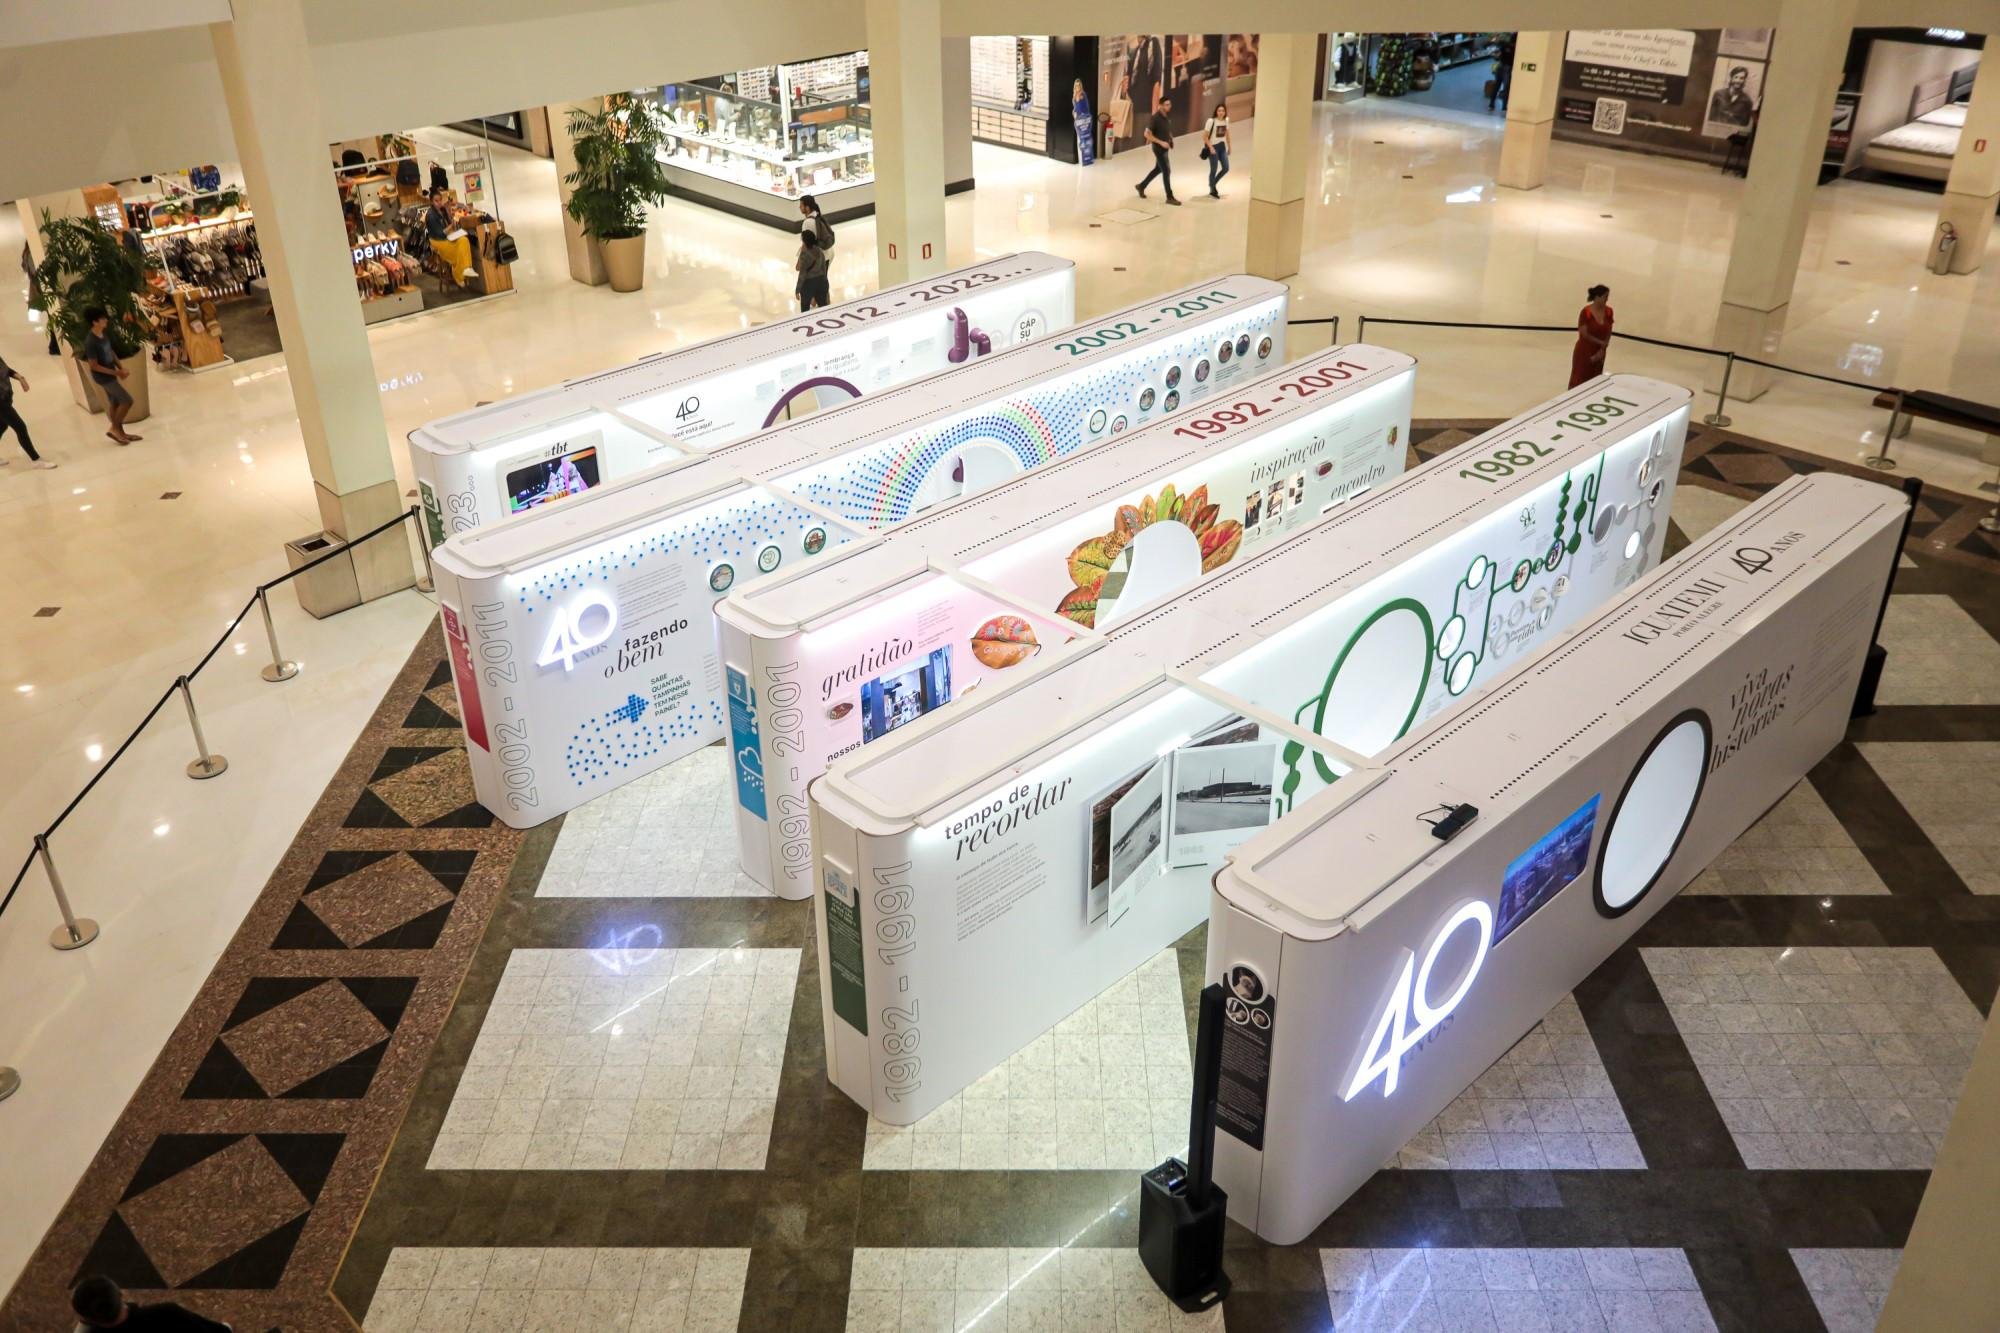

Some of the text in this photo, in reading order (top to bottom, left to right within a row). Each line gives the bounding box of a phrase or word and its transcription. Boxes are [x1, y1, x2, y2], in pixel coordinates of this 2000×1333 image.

[353, 239, 399, 263] perky
[792, 306, 888, 337] 2012
[910, 267, 1032, 301] 2023...
[1054, 322, 1149, 356] 2002
[1160, 290, 1238, 319] 2011
[675, 396, 700, 422] 40
[1173, 402, 1272, 440] 1992
[1279, 361, 1368, 397] 2001
[543, 440, 569, 459] #tbt
[1250, 436, 1325, 484] inspiração
[1459, 440, 1554, 483] 1982
[1556, 396, 1639, 432] 1991
[448, 474, 481, 535] 23...
[1330, 462, 1385, 500] encontro
[1729, 530, 1806, 576] 40 ANOS
[535, 588, 618, 672] 40
[624, 619, 688, 652] fazendo
[1621, 577, 1727, 646] IGUATEMI
[472, 601, 517, 687] 2011
[604, 641, 664, 679] o bem
[822, 638, 913, 702] gratidão
[650, 673, 668, 685] SABE
[651, 674, 684, 693] QUANTAS
[653, 680, 691, 700] TAMPINHAS
[654, 689, 689, 709] TEM NESSE
[1731, 667, 1768, 710] viva
[655, 701, 681, 717] PAINEL?
[766, 662, 805, 757] 2001
[494, 718, 539, 811] 2002
[827, 740, 861, 763] nossos
[777, 788, 812, 880] 1992
[945, 784, 1030, 840] tempo de
[956, 776, 1072, 861] recordar
[872, 860, 916, 966] 1991
[1341, 898, 1493, 1103] 40
[881, 998, 922, 1103] 1982
